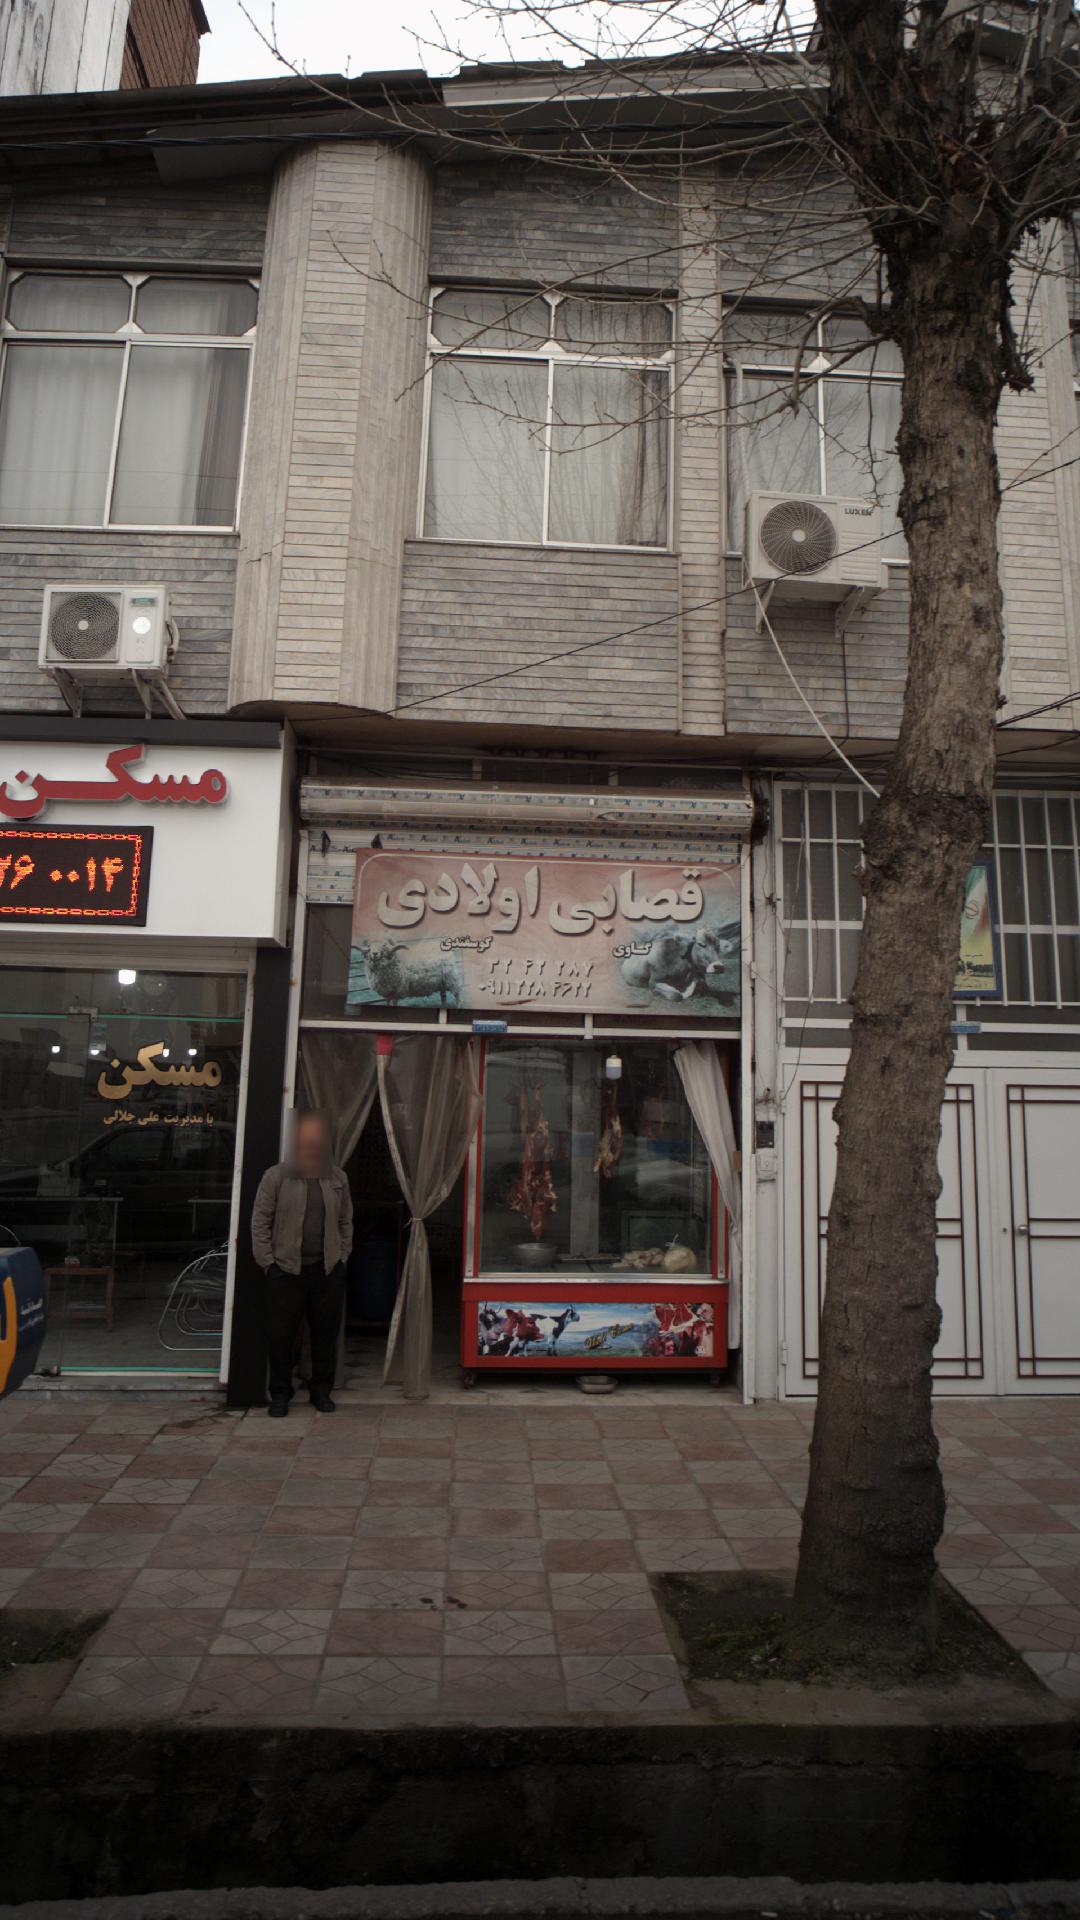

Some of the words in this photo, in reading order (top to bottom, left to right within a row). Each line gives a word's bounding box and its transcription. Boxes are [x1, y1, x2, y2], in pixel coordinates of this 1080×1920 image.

[0, 743, 229, 820] مسکن
[377, 862, 541, 934] اولادی
[550, 867, 705, 936] قصابی
[440, 935, 494, 953] گوسفندی
[612, 940, 653, 958] گاوی
[97, 1041, 222, 1100] مسکن
[104, 1109, 136, 1125] جلالی
[138, 1111, 160, 1125] علی
[163, 1114, 203, 1126] مدیریت
